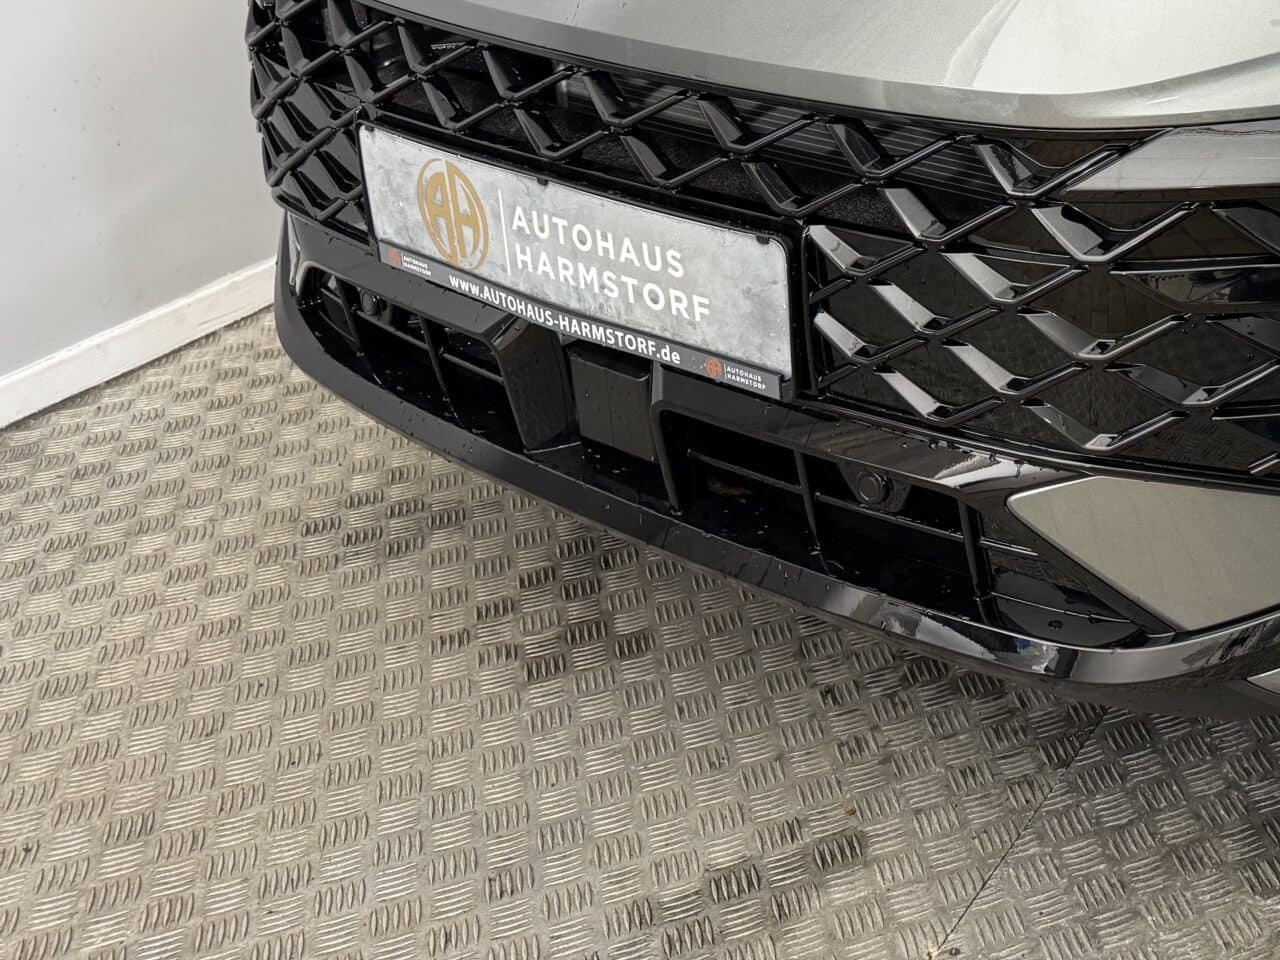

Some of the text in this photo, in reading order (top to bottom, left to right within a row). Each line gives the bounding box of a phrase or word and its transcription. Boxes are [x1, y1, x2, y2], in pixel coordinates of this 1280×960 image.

[512, 206, 685, 278] AUTOHAUS
[515, 243, 711, 322] HARMSTORF
[449, 274, 681, 365] www.AUTOHAUS-HARMSTORF.de
[726, 366, 762, 382] AUTOHAUS
[727, 373, 767, 390] HARMSTORF
